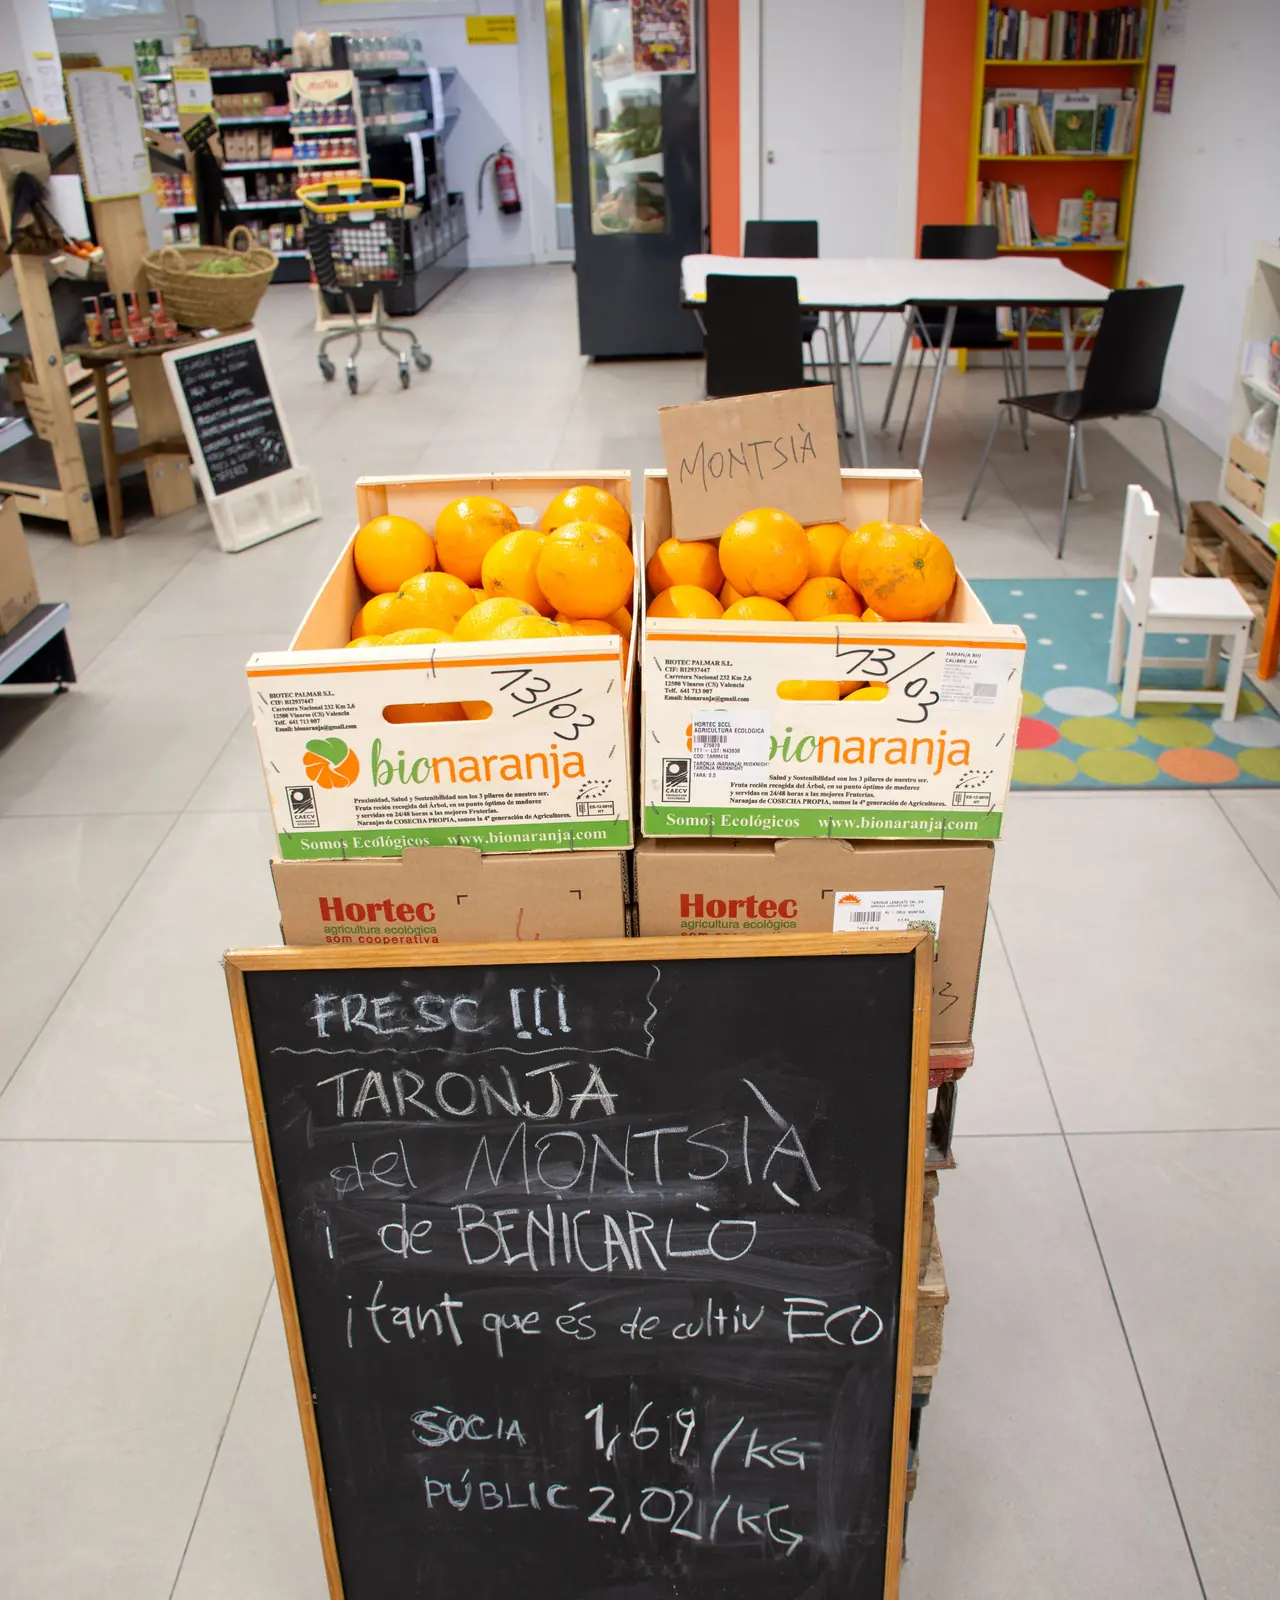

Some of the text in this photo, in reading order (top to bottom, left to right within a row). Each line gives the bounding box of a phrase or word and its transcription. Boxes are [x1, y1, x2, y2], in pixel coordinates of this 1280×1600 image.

[679, 423, 817, 492] MONTSIÀ
[371, 737, 586, 789] bionaranja
[792, 774, 836, 782] Sostenibilidad
[864, 776, 885, 784] pilares
[806, 782, 826, 790] Árbol,
[373, 803, 390, 811] recién
[392, 803, 418, 811] recogida
[484, 799, 506, 807] óptimo
[802, 798, 831, 806] PROPIA,
[867, 799, 900, 807] generación
[820, 791, 844, 799] mejores
[845, 791, 875, 799] Fruterías.
[357, 819, 385, 827] Naranjas
[393, 817, 427, 825] COSECHA
[428, 816, 457, 824] PROPIA,
[491, 813, 525, 822] generación
[533, 811, 572, 820] Agricultores.
[443, 809, 468, 817] mejores
[666, 813, 979, 832] Somos Ecológicos www.bionaranja.com
[300, 828, 607, 850] Somos Ecológicos www.bionaranja.com
[318, 896, 436, 922] Hortec
[680, 893, 798, 918] Hortec
[323, 925, 381, 936] agricultura
[680, 919, 740, 930] agricultura
[326, 934, 440, 944] som cooperativa
[310, 986, 572, 1040] FRESC !!!
[316, 1060, 619, 1120] TARONJA
[330, 1078, 821, 1195] del MONTSIÀ
[377, 1202, 433, 1259] de
[483, 1311, 542, 1358] que
[555, 1302, 596, 1340] és
[620, 1306, 661, 1340] de
[782, 1297, 884, 1346] ECO
[425, 1468, 580, 1512] PÚBLIC
